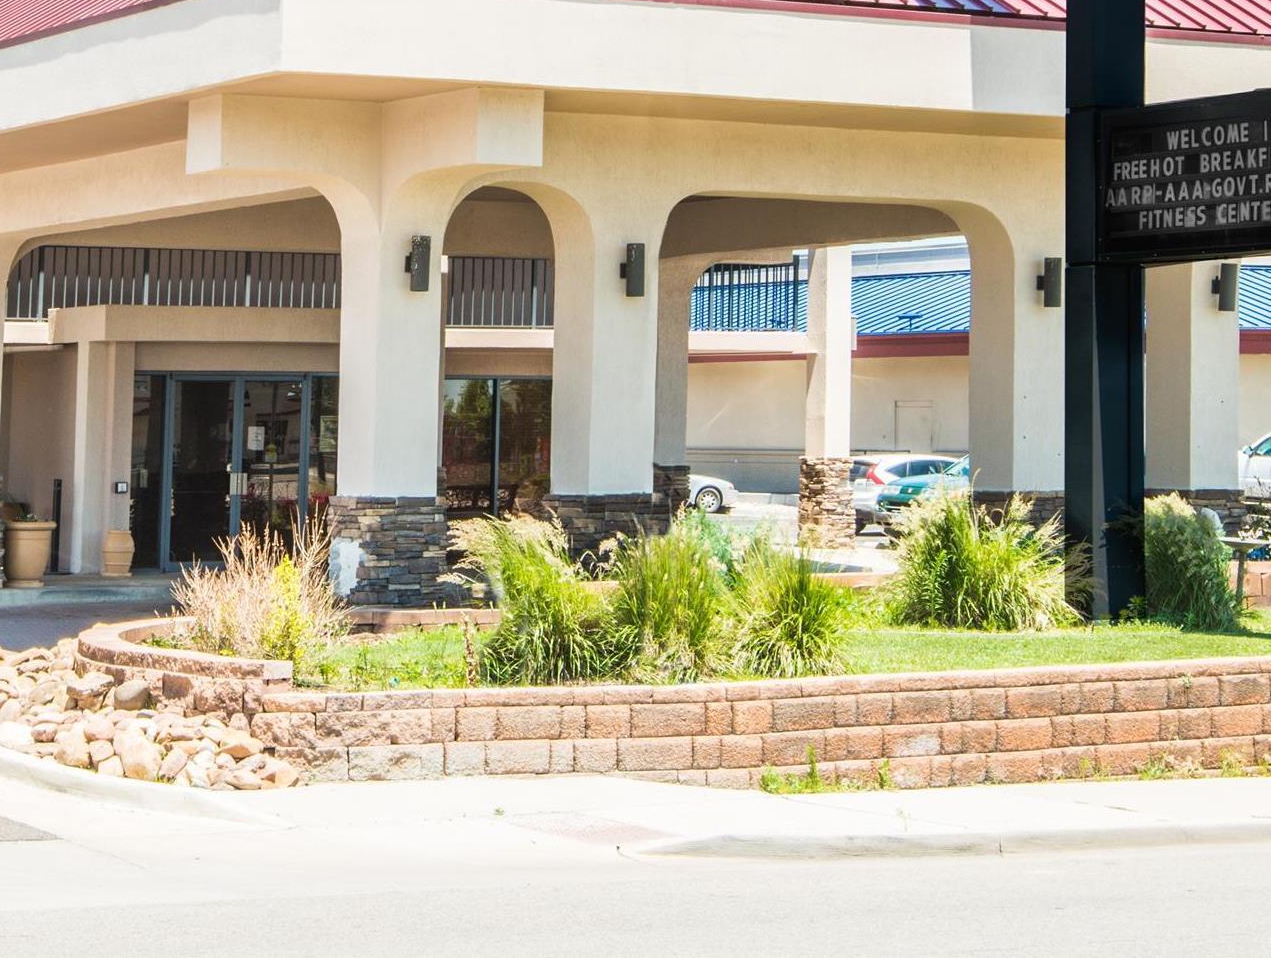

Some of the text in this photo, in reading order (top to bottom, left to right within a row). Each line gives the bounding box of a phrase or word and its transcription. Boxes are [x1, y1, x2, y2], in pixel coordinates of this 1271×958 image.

[1166, 122, 1249, 151] WELCOME
[1199, 147, 1268, 173] BREAKF
[1139, 200, 1271, 231] FITNESS CENTE
